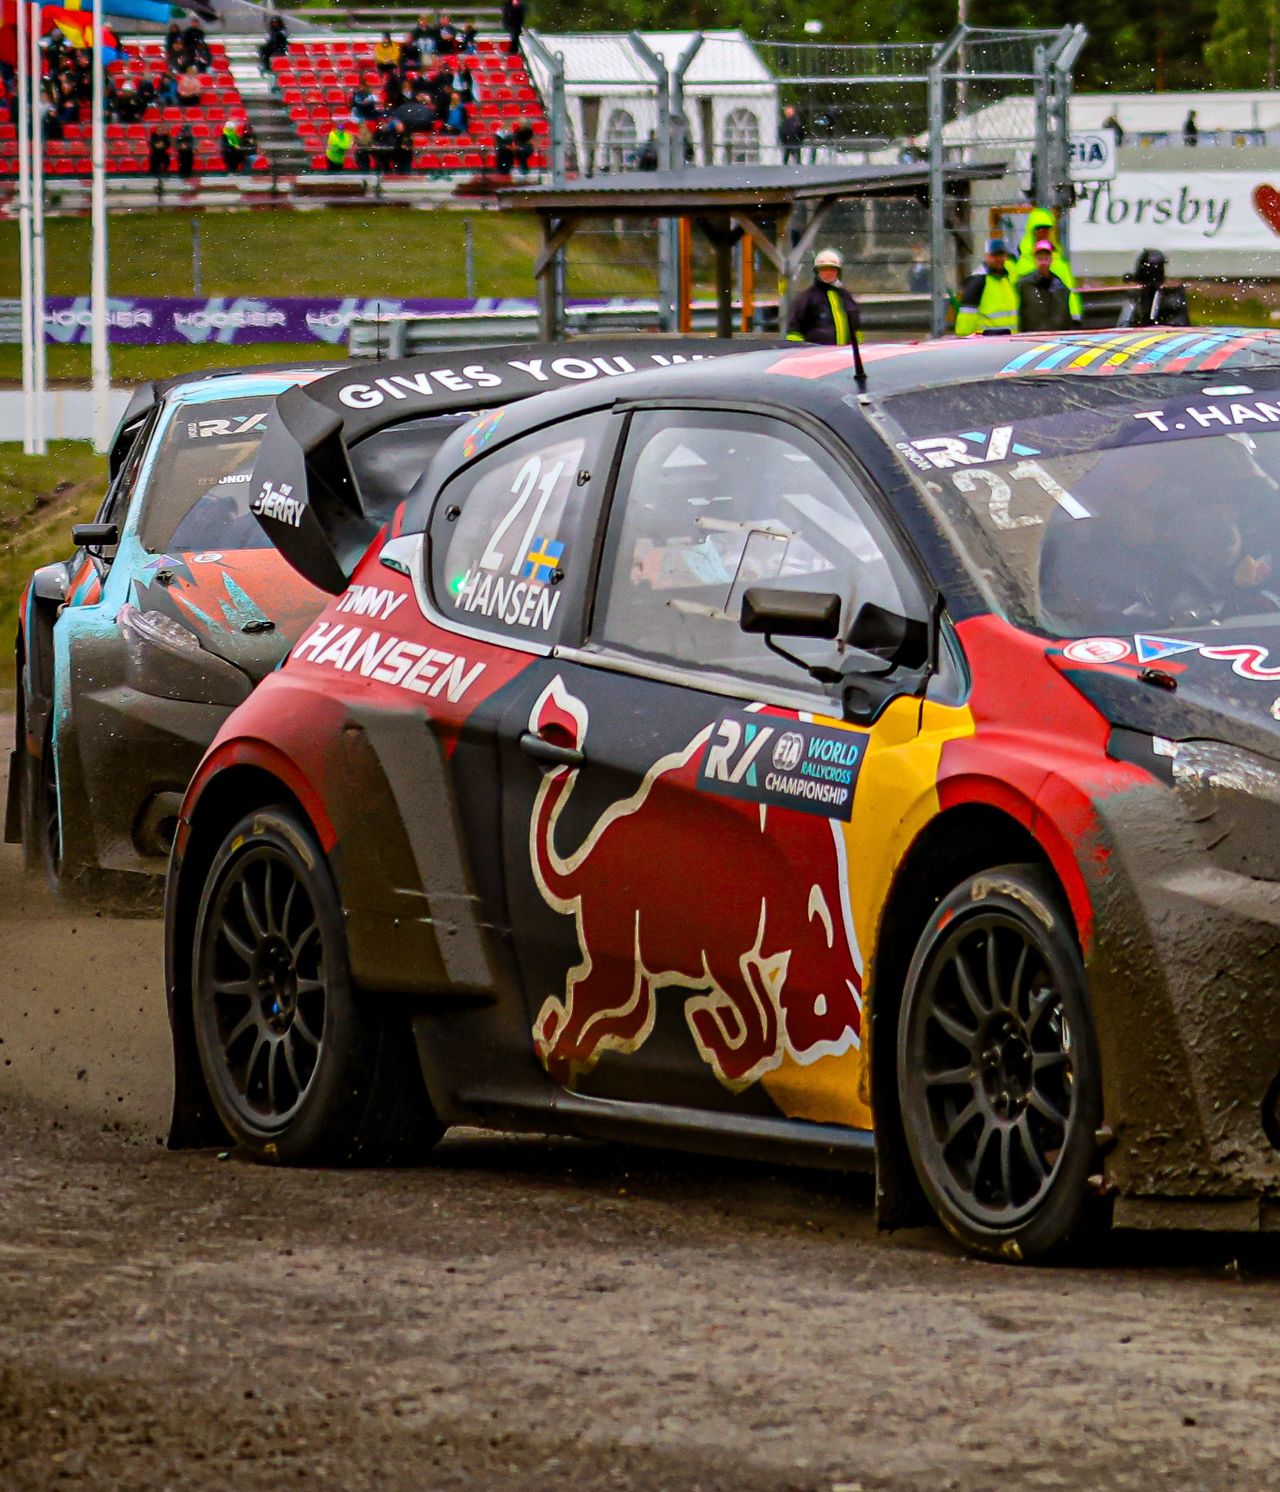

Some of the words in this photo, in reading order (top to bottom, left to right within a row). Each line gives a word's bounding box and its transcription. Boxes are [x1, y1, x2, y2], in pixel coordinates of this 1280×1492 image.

[1085, 184, 1230, 237] Torsby
[173, 311, 286, 328] HOOSIER
[338, 363, 503, 410] GIVES
[508, 355, 637, 383] YOU
[199, 413, 269, 438] RX
[1134, 409, 1184, 432] T.
[910, 425, 1041, 469] RX
[480, 456, 565, 576] 21
[952, 458, 1092, 530] 21
[336, 584, 407, 620] TIMMY
[454, 568, 561, 631] HANSEN
[292, 621, 486, 704] HANSEN
[704, 718, 775, 787] RX
[807, 736, 858, 766] WORLD
[800, 761, 852, 785] RALLYCROSS
[765, 772, 848, 806] CHAMPIONSHIP
